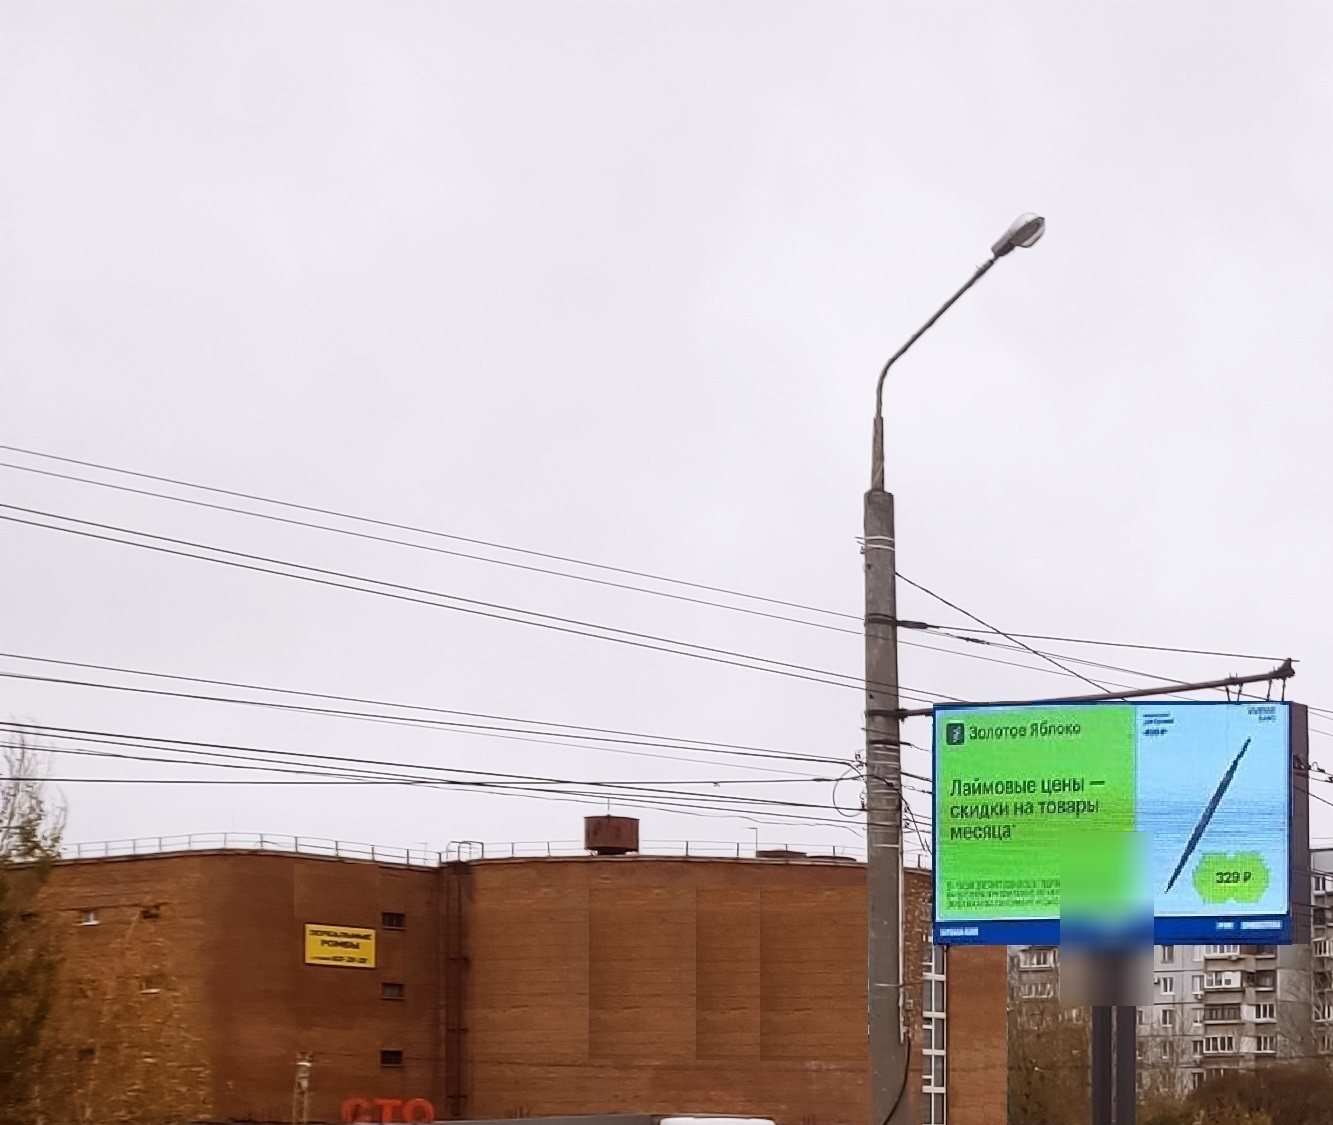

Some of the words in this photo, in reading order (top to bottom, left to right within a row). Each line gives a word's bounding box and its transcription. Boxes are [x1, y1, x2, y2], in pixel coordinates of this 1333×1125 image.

[969, 725, 1027, 740] Золотое
[1030, 720, 1081, 737] Яблоко
[950, 777, 1036, 796] Лаймовые
[1041, 777, 1085, 794] цены
[950, 802, 1009, 819] скидки
[1014, 801, 1034, 815] на
[1038, 799, 1099, 818] товары
[341, 1098, 435, 1124] СТО
